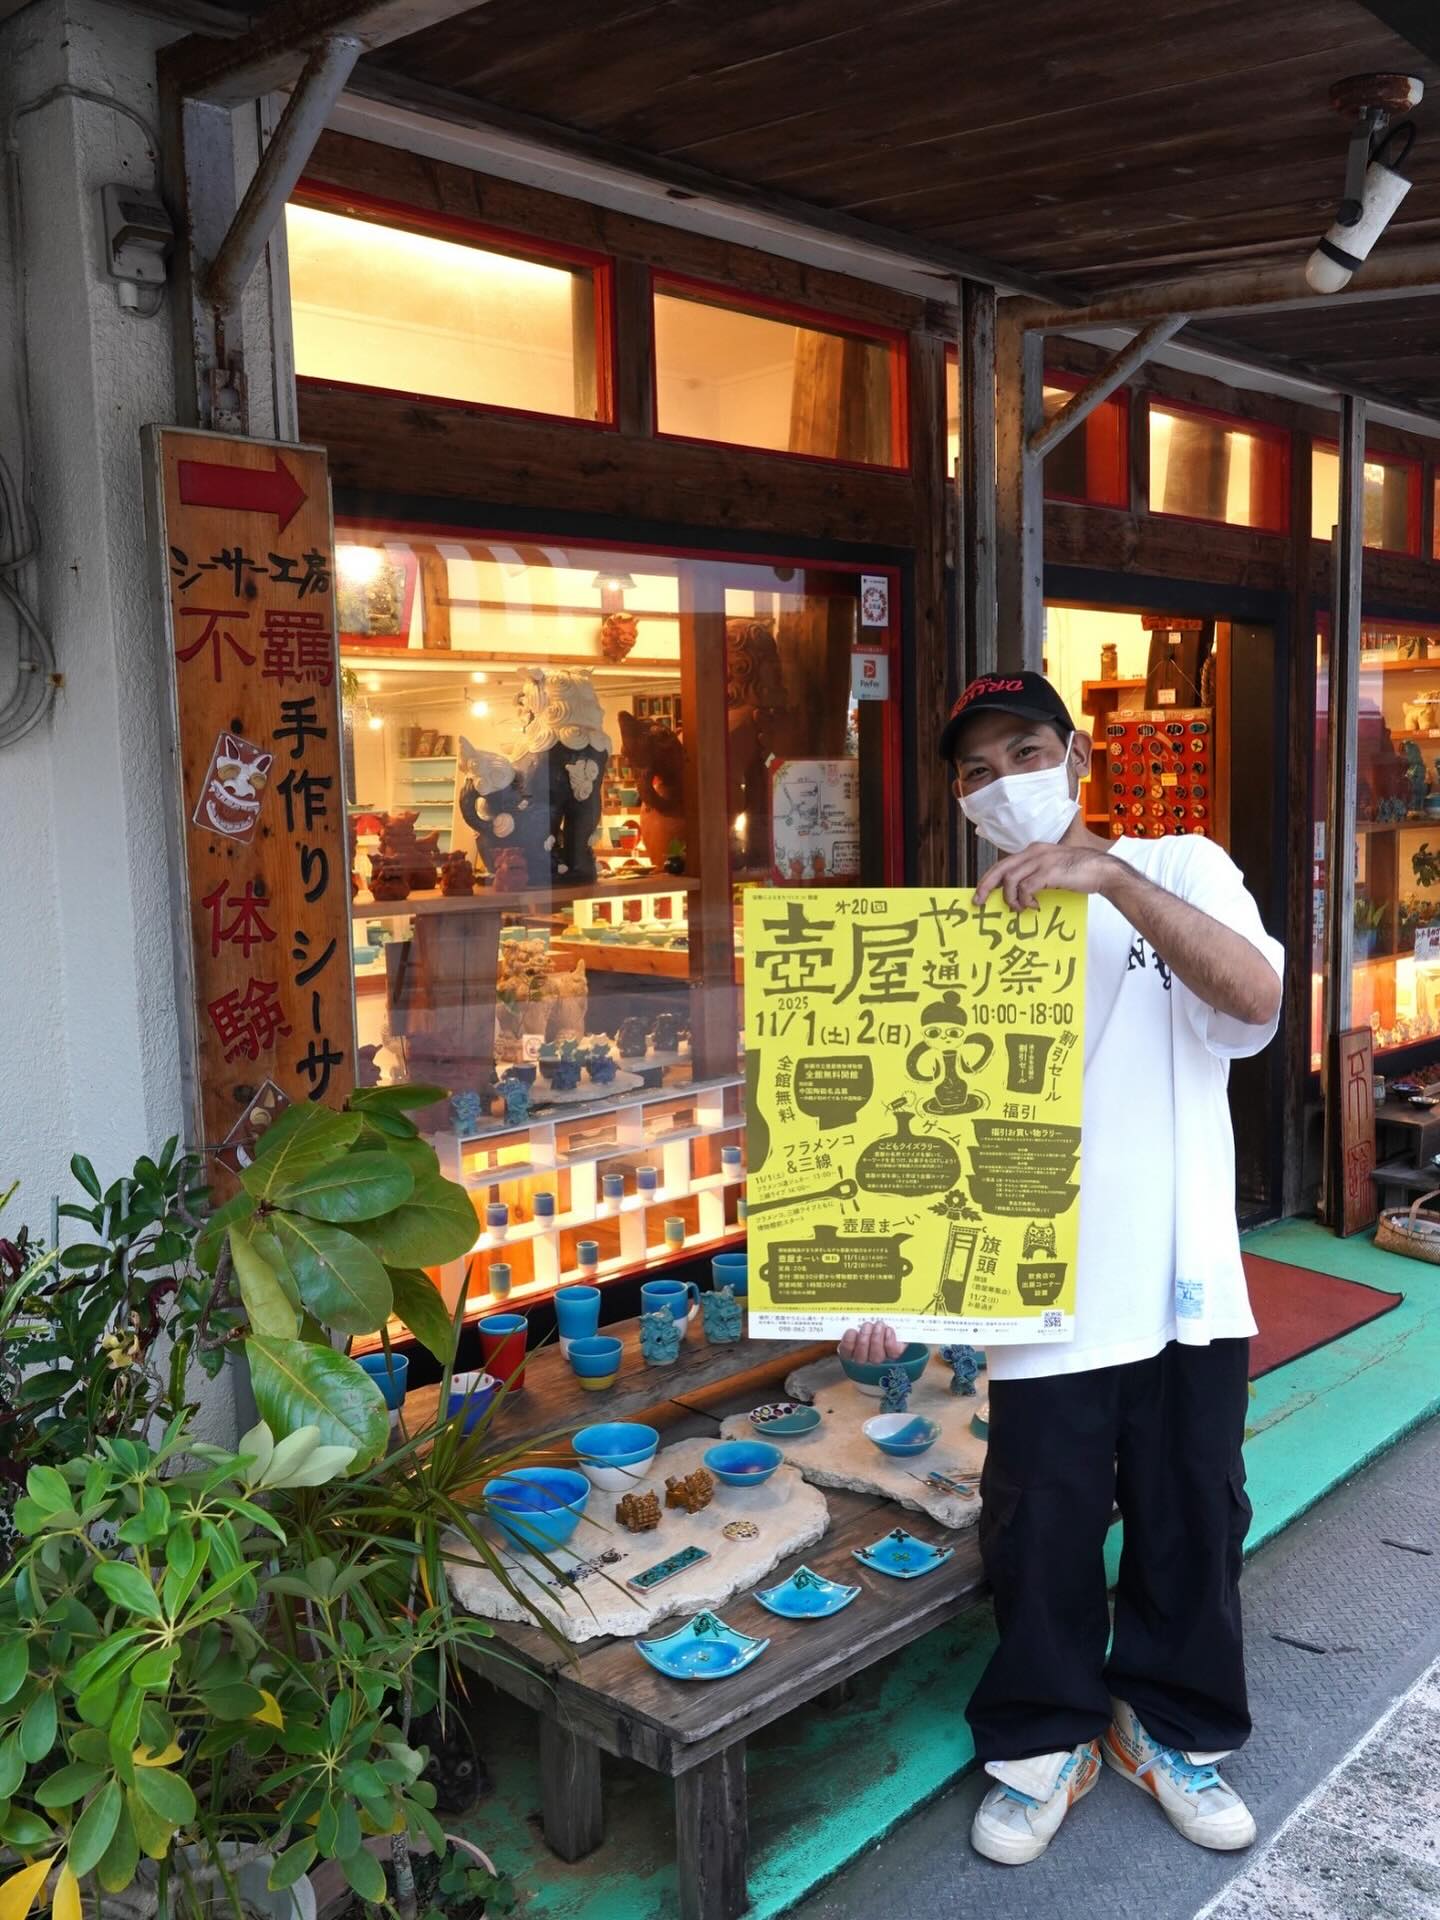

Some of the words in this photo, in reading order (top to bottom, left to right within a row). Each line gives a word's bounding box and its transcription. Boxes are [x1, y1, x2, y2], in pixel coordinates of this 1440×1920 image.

[170, 546, 331, 599] シーサー工房
[175, 606, 334, 689] 不羈
[201, 877, 293, 1065] 体験
[922, 945, 1077, 997] 通り祭り
[778, 996, 809, 1011] 2025
[972, 1003, 1074, 1026] 10:00-18:00
[1045, 1030, 1079, 1102] 割引セール
[775, 1055, 796, 1124] 全館無料
[1003, 1102, 1037, 1120] 福引
[783, 1134, 856, 1158] フラメンコ
[923, 1120, 961, 1147] ゲーム
[991, 1128, 1064, 1138] 福引お買い物ラリー
[976, 1234, 1002, 1276] 旗頭
